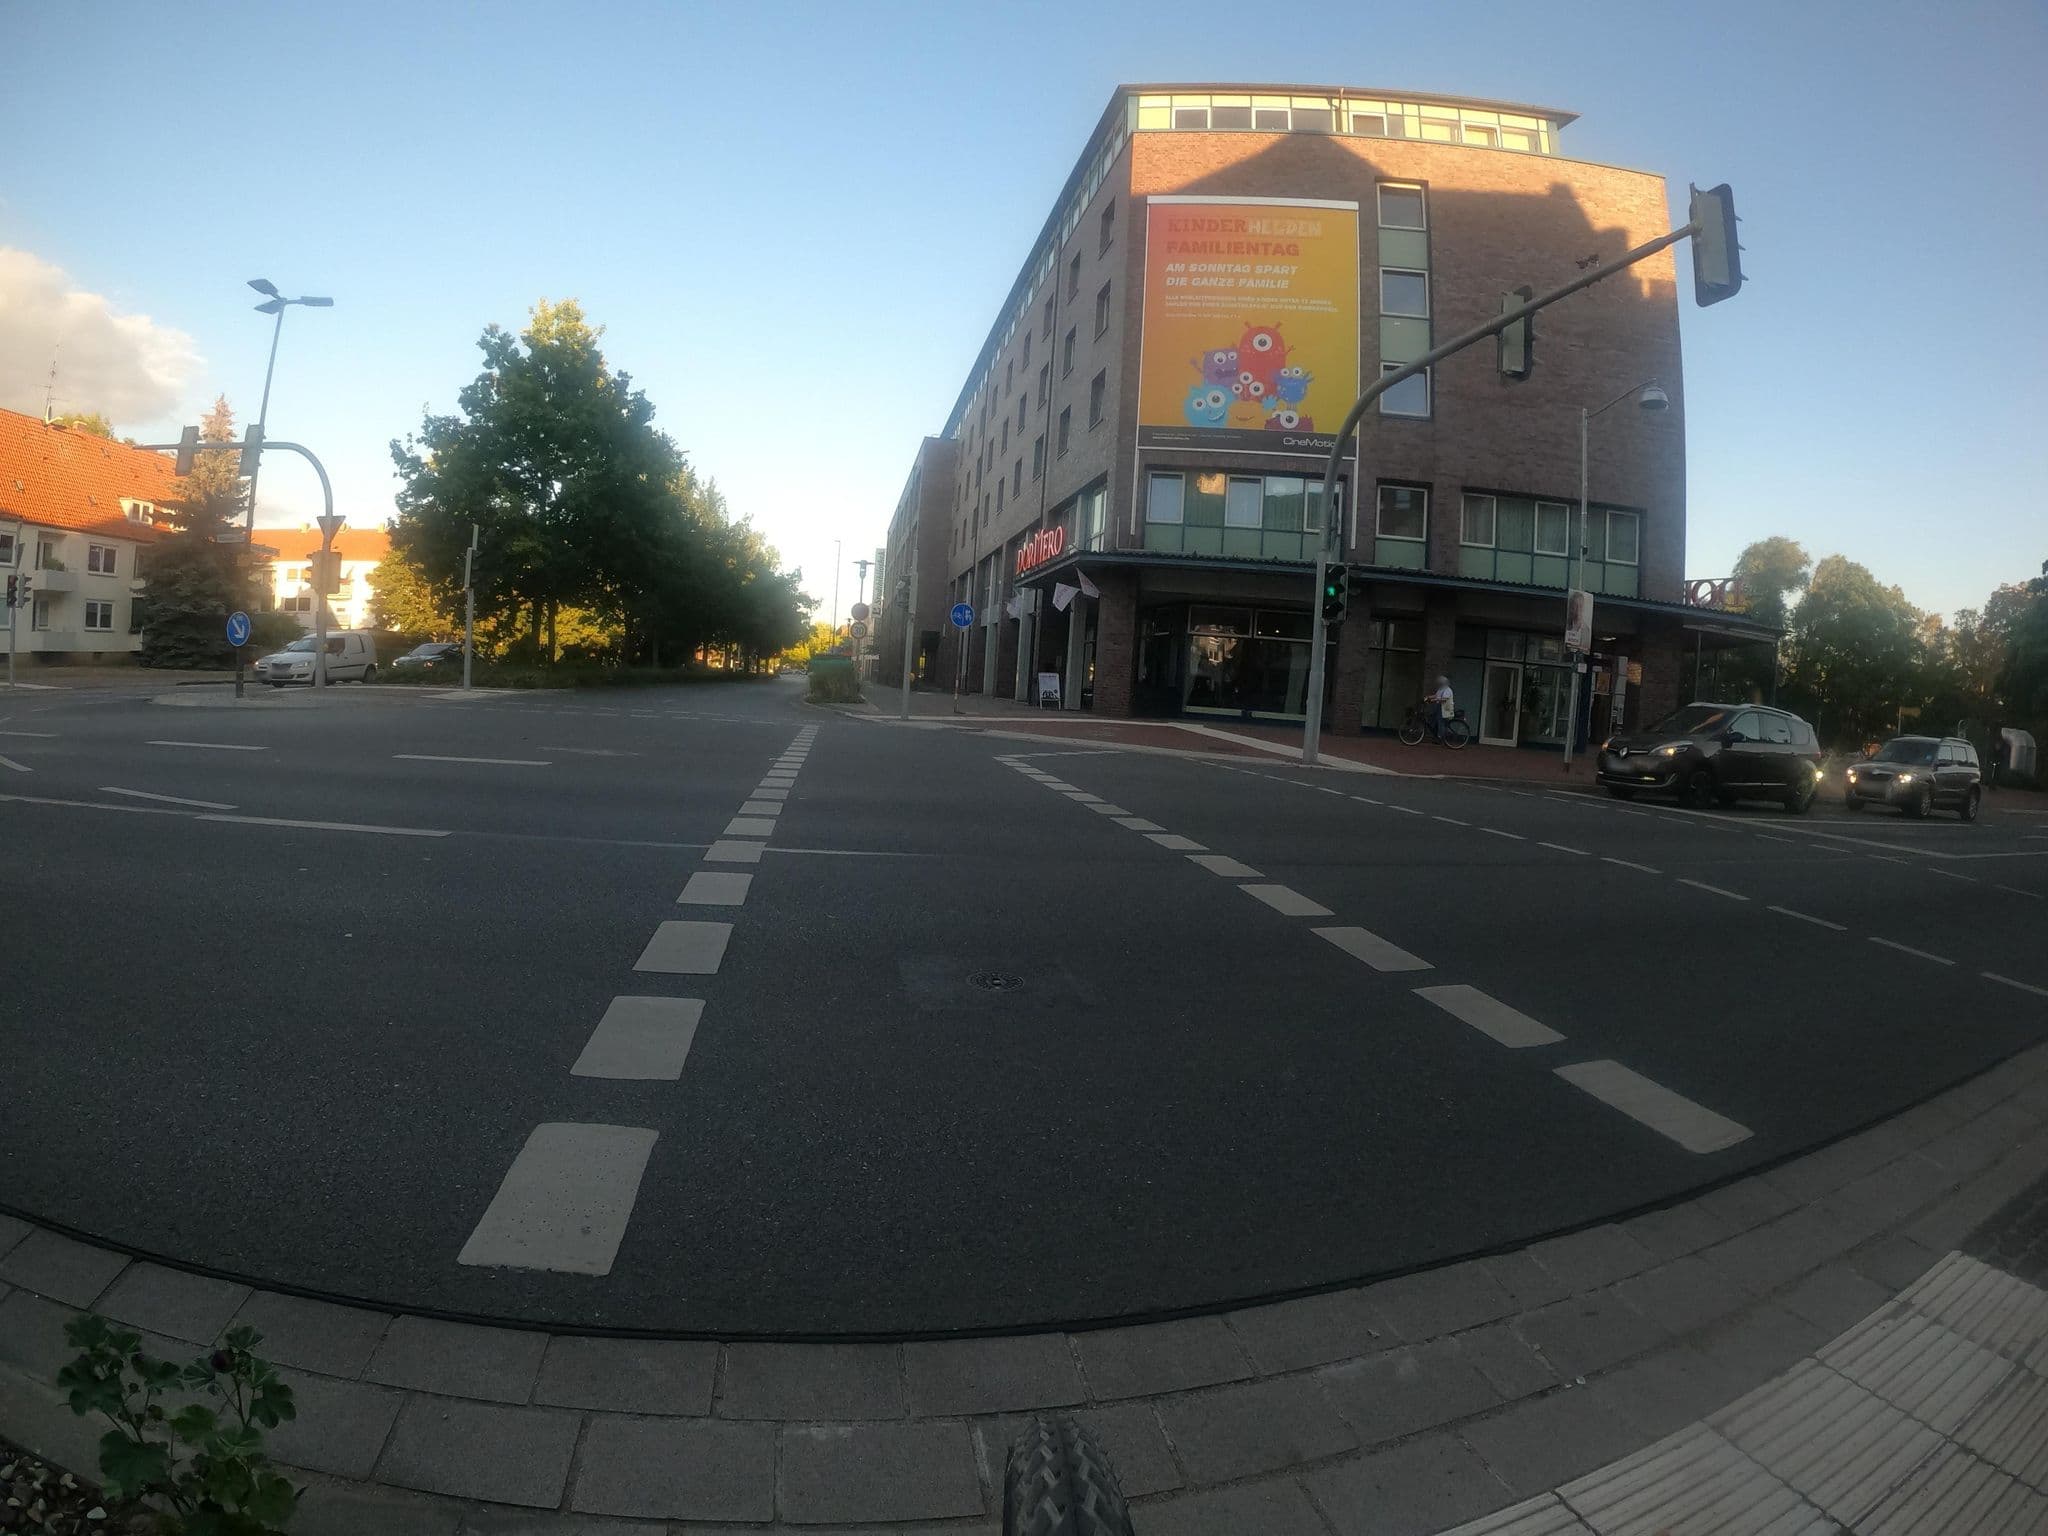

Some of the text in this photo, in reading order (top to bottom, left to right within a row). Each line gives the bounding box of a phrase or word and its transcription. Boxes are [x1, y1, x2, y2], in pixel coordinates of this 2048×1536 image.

[1166, 241, 1300, 257] FAMILIENTAG
[1165, 263, 1299, 275] AM SONNTAG SPART
[1166, 277, 1290, 288] DIE GANZE FAMILIE
[1283, 437, 1336, 448] CineMotio
[1016, 526, 1064, 574] DORMERO
